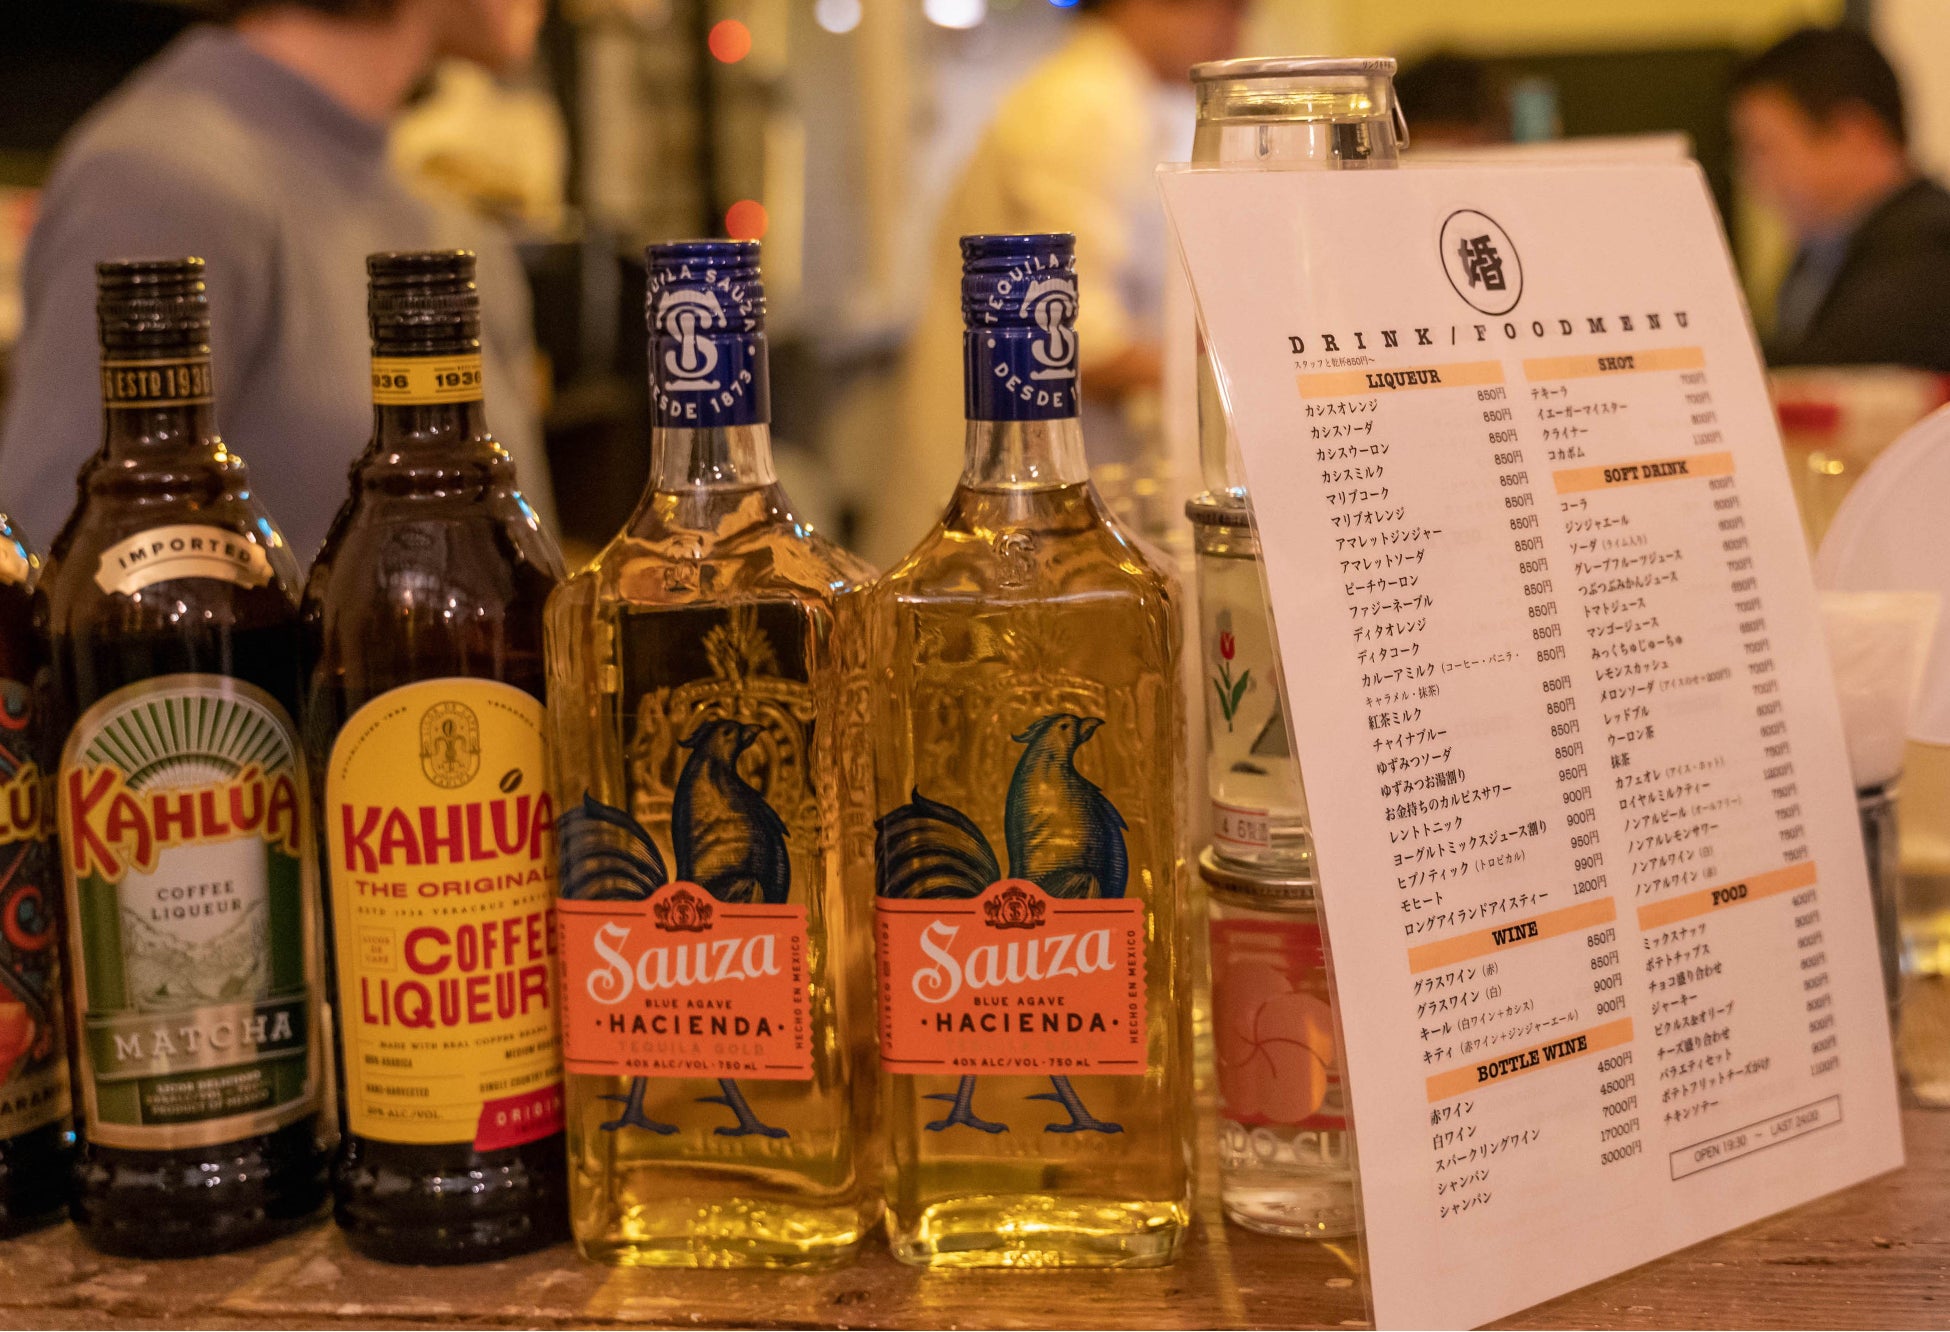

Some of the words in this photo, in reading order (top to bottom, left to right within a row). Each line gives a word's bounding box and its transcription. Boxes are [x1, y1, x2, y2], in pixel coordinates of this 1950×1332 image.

[1458, 234, 1506, 291] 婚
[705, 269, 755, 331] SAUZA
[985, 253, 1059, 323] TEQUILA
[1366, 369, 1441, 389] LIQUEUR
[1598, 356, 1634, 371] SHOT
[710, 369, 752, 413] 1873
[994, 362, 1063, 407] DESDE
[1531, 386, 1568, 400] テキーラ
[1305, 399, 1378, 417] カシスオレンジ
[1477, 387, 1507, 401] 850円
[1538, 402, 1628, 421] イエーガーマイスター
[1311, 421, 1374, 439] カシスソーダ
[1483, 408, 1512, 422] 850円
[1543, 427, 1588, 441] クライナー
[1317, 443, 1389, 461] カシスウーロン
[1489, 429, 1518, 443] 850円
[1322, 466, 1384, 483] カシスミルク
[1494, 450, 1523, 465] 850円
[1604, 467, 1638, 483] SOFT
[1643, 461, 1689, 479] DRINK
[1326, 487, 1389, 506] マリブコーク
[1500, 472, 1529, 487] 850円
[1331, 507, 1405, 527] マリブオレンジ
[1505, 493, 1534, 508] 850円
[1561, 499, 1588, 512] コーラ
[1336, 527, 1442, 550] アマレットジンジャー
[1510, 514, 1539, 530] 850円
[1566, 515, 1629, 534] ジンジャエール
[117, 536, 253, 569] IMPORTED
[1340, 549, 1425, 573] アマレットソーダ
[1515, 536, 1544, 552] 850円
[1575, 550, 1683, 576] グレープフルーツジュース
[1345, 575, 1418, 596] ピーチウーロン
[1520, 558, 1548, 573] 850円
[1350, 595, 1433, 618] ファジーネーブル
[1524, 580, 1553, 596] 850円
[1584, 597, 1646, 618] トマトジュース
[1353, 618, 1427, 640] ディタオレンジ
[1529, 602, 1557, 618] 850円
[1587, 617, 1659, 638] マンゴージュース
[1357, 643, 1419, 665] ディタコーク
[1533, 624, 1561, 640] 850円
[1537, 645, 1566, 662] 850円
[1596, 660, 1669, 681] レモンスカッシュ
[1368, 708, 1422, 730] 紅茶ミルク
[1543, 675, 1572, 692] 850円
[1605, 705, 1649, 725] レッドブル
[1373, 728, 1447, 752] チャイナブルー
[1547, 697, 1576, 714] 850円
[1608, 726, 1654, 746] ウーロン茶
[1377, 747, 1452, 775] ゆずみつソーダ
[1551, 719, 1580, 737] 850円
[1611, 752, 1630, 769] 抹茶
[1381, 768, 1466, 798] ゆずみつお湯割り
[1555, 741, 1584, 759] 850円
[1385, 784, 1512, 821] お金持ちのカルピスサワー
[1559, 763, 1588, 782] 950円
[1619, 781, 1711, 809] ロイヤルミルクティー
[69, 766, 300, 877] KAHLÚA
[1390, 816, 1463, 843] レントトニック
[1563, 786, 1592, 804] 900円
[1394, 820, 1547, 867] ヨーグルトミックスジュース割り
[1567, 808, 1596, 826] 900円
[1571, 830, 1600, 848] 950円
[1629, 824, 1719, 853] ノンアルレモンサワー
[158, 881, 234, 901] COFFEE
[356, 880, 407, 898] THE
[418, 867, 556, 897] ORIGINAL
[1401, 891, 1443, 913] モヒート
[1575, 852, 1603, 871] 990円
[1711, 883, 1747, 905] FOOD
[152, 899, 241, 920] LIQUEUR
[1405, 892, 1549, 936] ロングアイランドアイスティー
[1573, 875, 1607, 895] 1200円
[1492, 921, 1539, 946] WINE
[1587, 928, 1616, 947] 850円
[1644, 923, 1706, 949] ミックスナッツ
[587, 921, 781, 1005] Sauza
[791, 935, 800, 983] MEXICO
[912, 920, 1116, 1004] Sauza
[1127, 930, 1136, 976] MEXICO
[1591, 950, 1619, 970] 850円
[1646, 944, 1710, 972] ポテトチップス
[361, 964, 549, 1029] LIQUEUR
[793, 987, 801, 1003] EN
[1128, 982, 1137, 998] EN
[1594, 972, 1623, 992] 900円
[645, 999, 678, 1009] BLUE
[687, 999, 733, 1010] AGAVE
[973, 996, 1009, 1006] BLUE
[1017, 996, 1065, 1006] AGAVE
[1597, 995, 1626, 1015] 900円
[1652, 993, 1698, 1015] ジャーキー
[114, 1012, 292, 1061] MATCHA
[610, 1013, 772, 1037] HACIENDA
[793, 1009, 804, 1050] HECHO
[936, 1012, 1107, 1033] HACIENDA
[1129, 1002, 1139, 1044] HECHO
[1477, 1050, 1540, 1083] BOTTLE
[1542, 1035, 1587, 1062] WINE
[1431, 1101, 1474, 1125] 赤ワイン
[1598, 1051, 1633, 1073] 4500円
[1433, 1125, 1477, 1151] 白ワイン
[1600, 1073, 1635, 1096] 4500円
[1664, 1100, 1718, 1124] チキンソテー
[1436, 1128, 1541, 1173] スパークリングワイン
[1602, 1095, 1638, 1117] 7000円
[1438, 1169, 1489, 1195] シャンパン
[1600, 1117, 1641, 1142] 17000円
[1694, 1146, 1720, 1163] OPEN
[1441, 1192, 1492, 1218] シャンパン
[1600, 1140, 1642, 1165] 30000円
